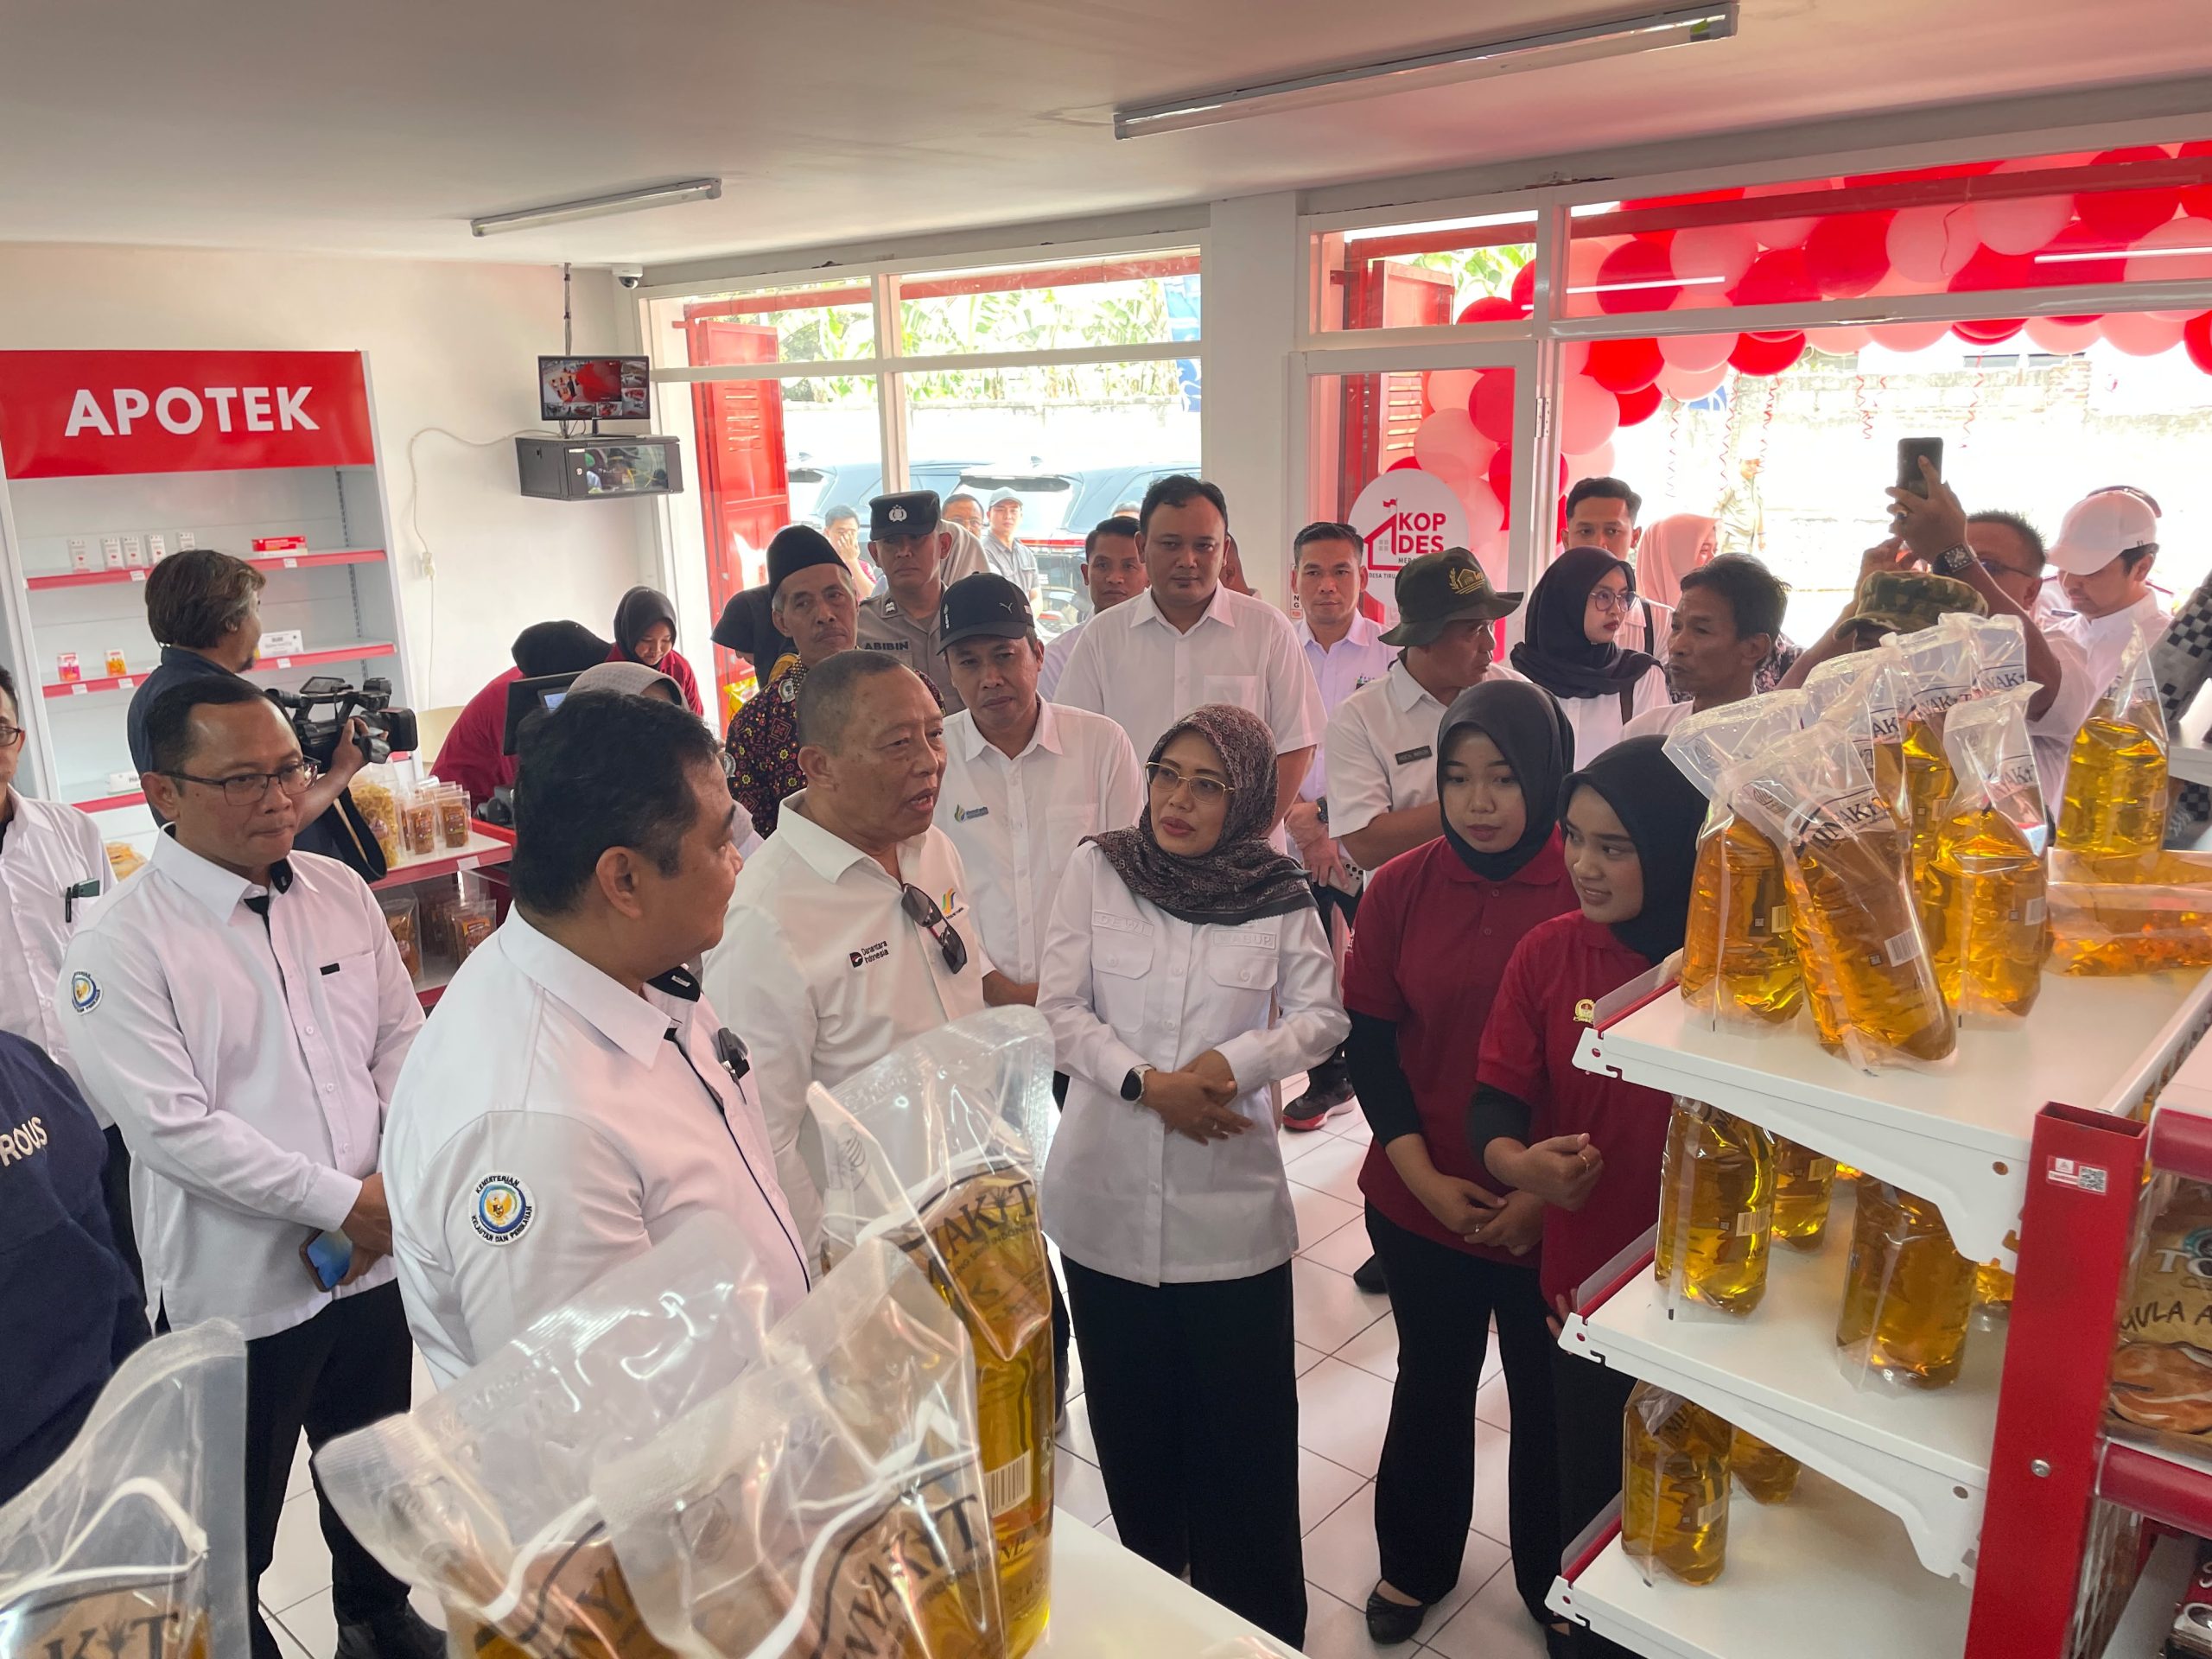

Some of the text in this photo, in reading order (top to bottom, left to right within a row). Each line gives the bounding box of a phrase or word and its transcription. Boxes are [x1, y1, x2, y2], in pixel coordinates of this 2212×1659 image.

[65, 386, 321, 437] APOTEK
[1398, 512, 1446, 531] KOP
[1398, 535, 1444, 554] DES
[864, 641, 909, 651] ABIBIN
[861, 940, 887, 956] Danantara
[864, 949, 889, 964] Indonesia
[0, 1116, 48, 1166] ROUS
[475, 1175, 520, 1194] KEMENTERIAN
